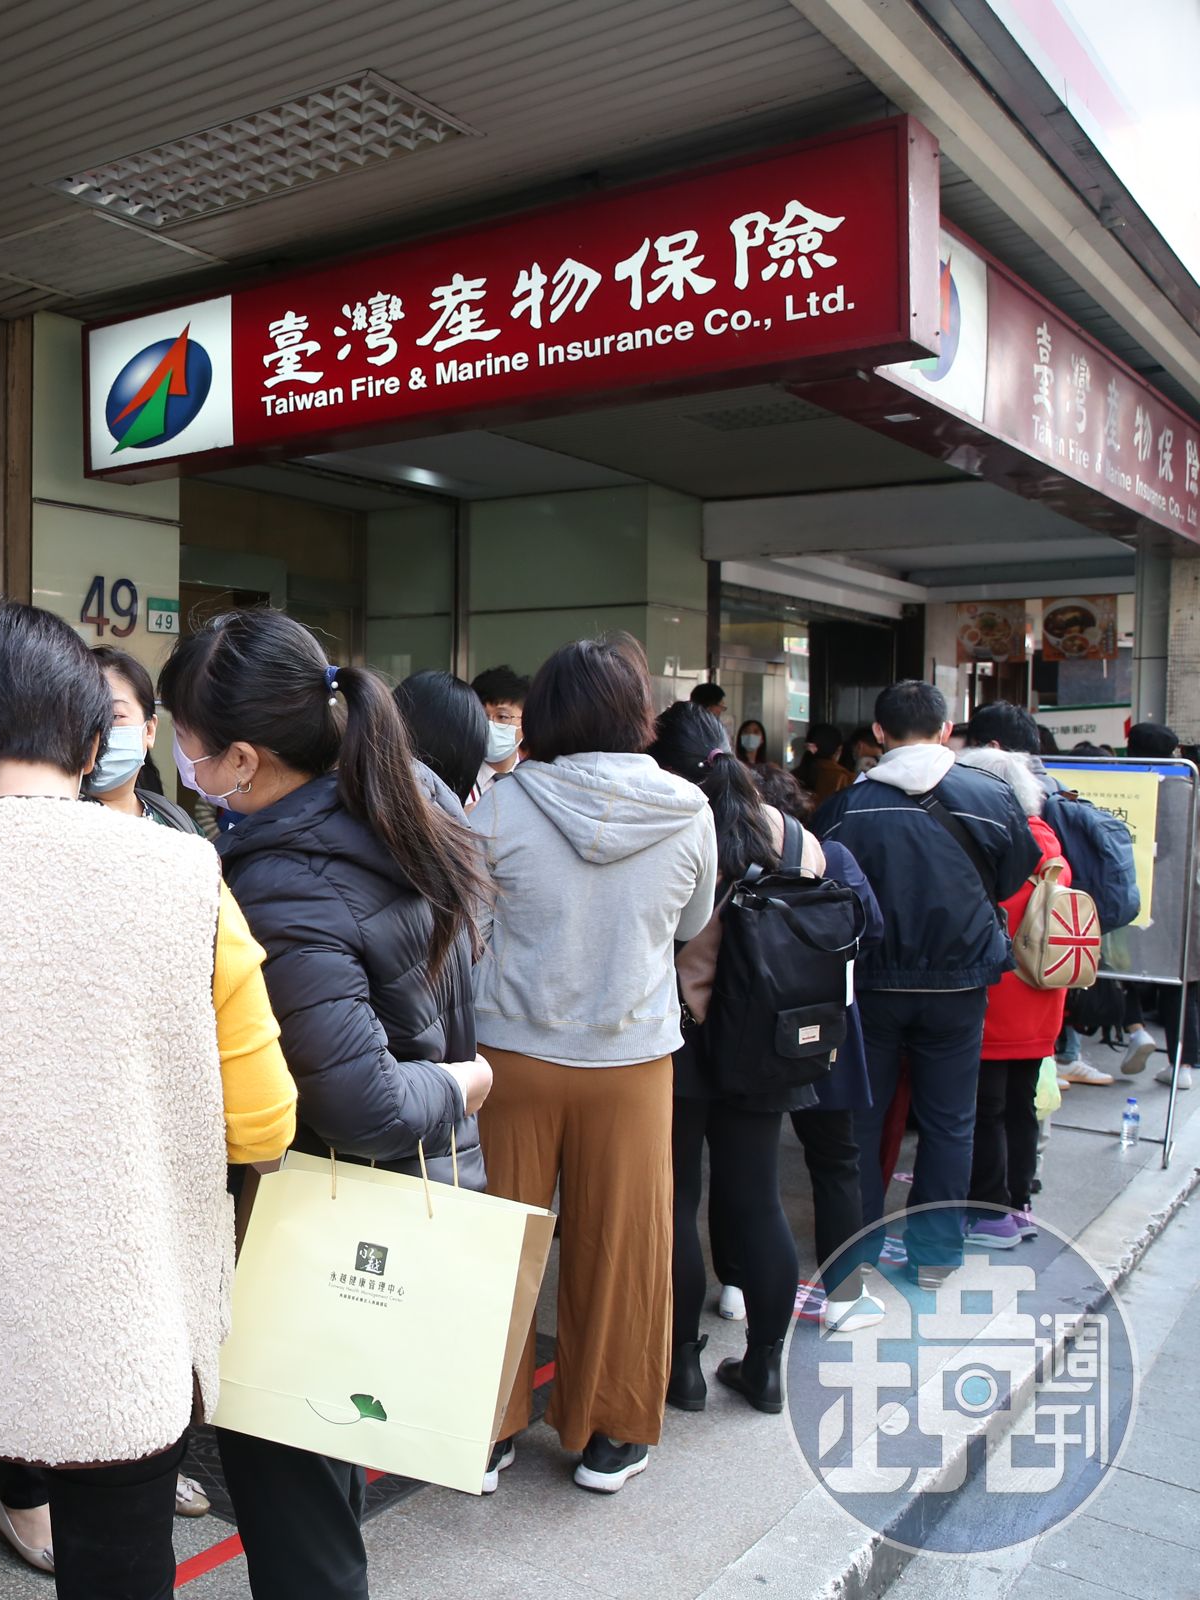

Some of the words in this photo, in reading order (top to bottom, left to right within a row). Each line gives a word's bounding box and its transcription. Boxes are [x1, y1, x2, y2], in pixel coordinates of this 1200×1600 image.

[262, 199, 846, 389] 臺灣產物保險
[260, 386, 344, 417] Taiwan
[351, 375, 401, 401] Fire
[408, 366, 428, 390] &
[435, 352, 529, 386] Marine
[538, 320, 694, 367] Insurance
[704, 308, 772, 335] Co.,
[785, 284, 855, 321] Ltd.
[1068, 438, 1090, 469] Fire
[80, 575, 138, 638] 49
[155, 614, 173, 630] 49
[330, 1270, 405, 1297] 永越健康管理中心
